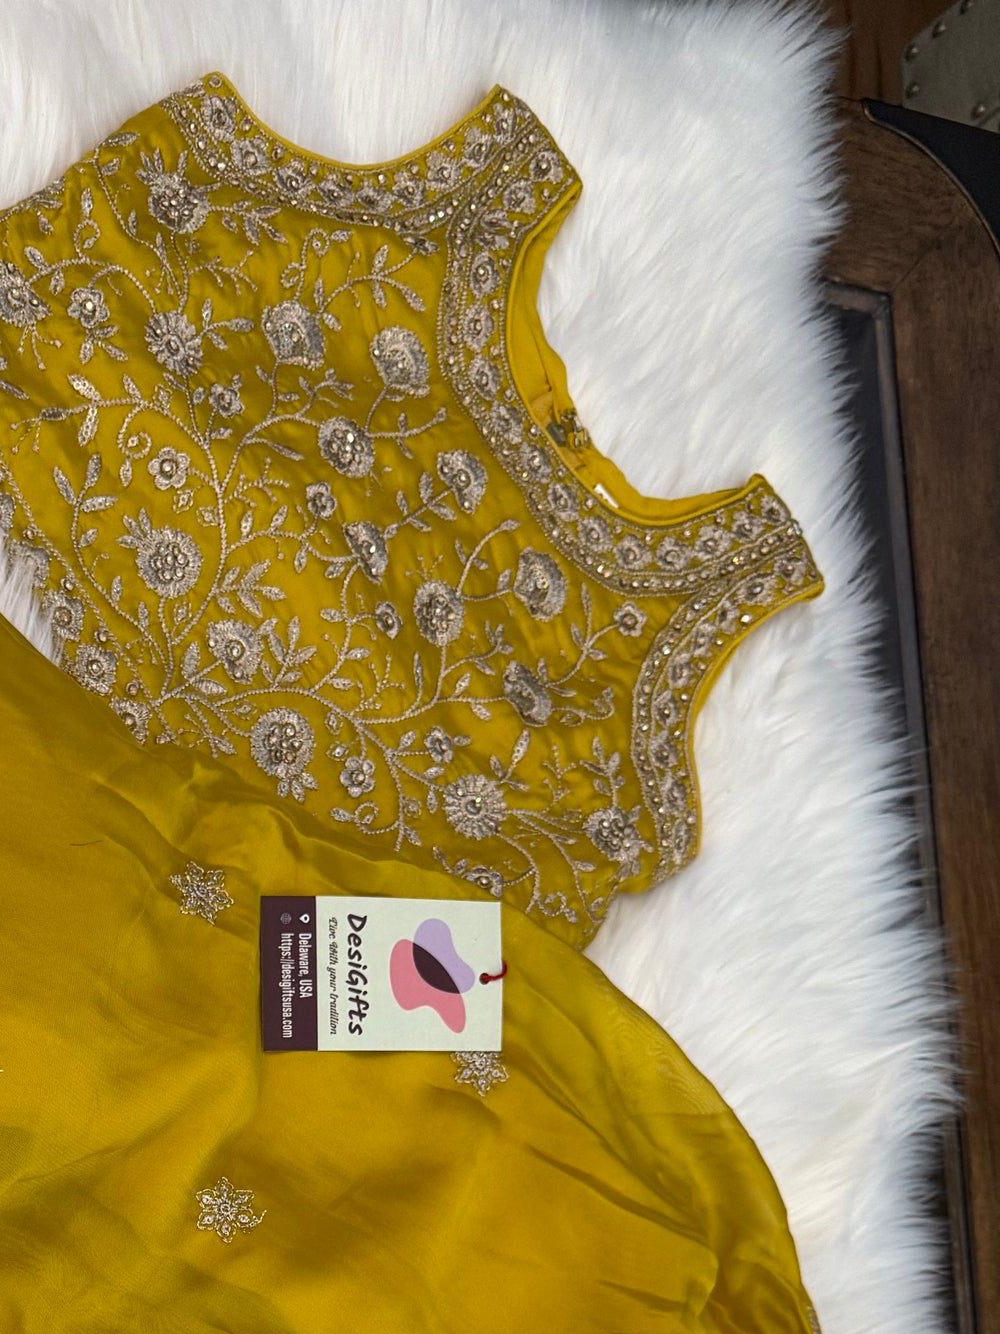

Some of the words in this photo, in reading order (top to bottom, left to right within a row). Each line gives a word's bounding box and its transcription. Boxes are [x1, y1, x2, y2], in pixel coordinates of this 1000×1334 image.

[298, 932, 312, 977] Delaware,
[328, 941, 339, 965] With
[346, 913, 370, 1036] DesiGifts
[278, 933, 295, 1038] https://desigiftsusa.com
[299, 979, 313, 998] USA
[326, 965, 337, 992] your
[329, 992, 340, 1035] tradition
